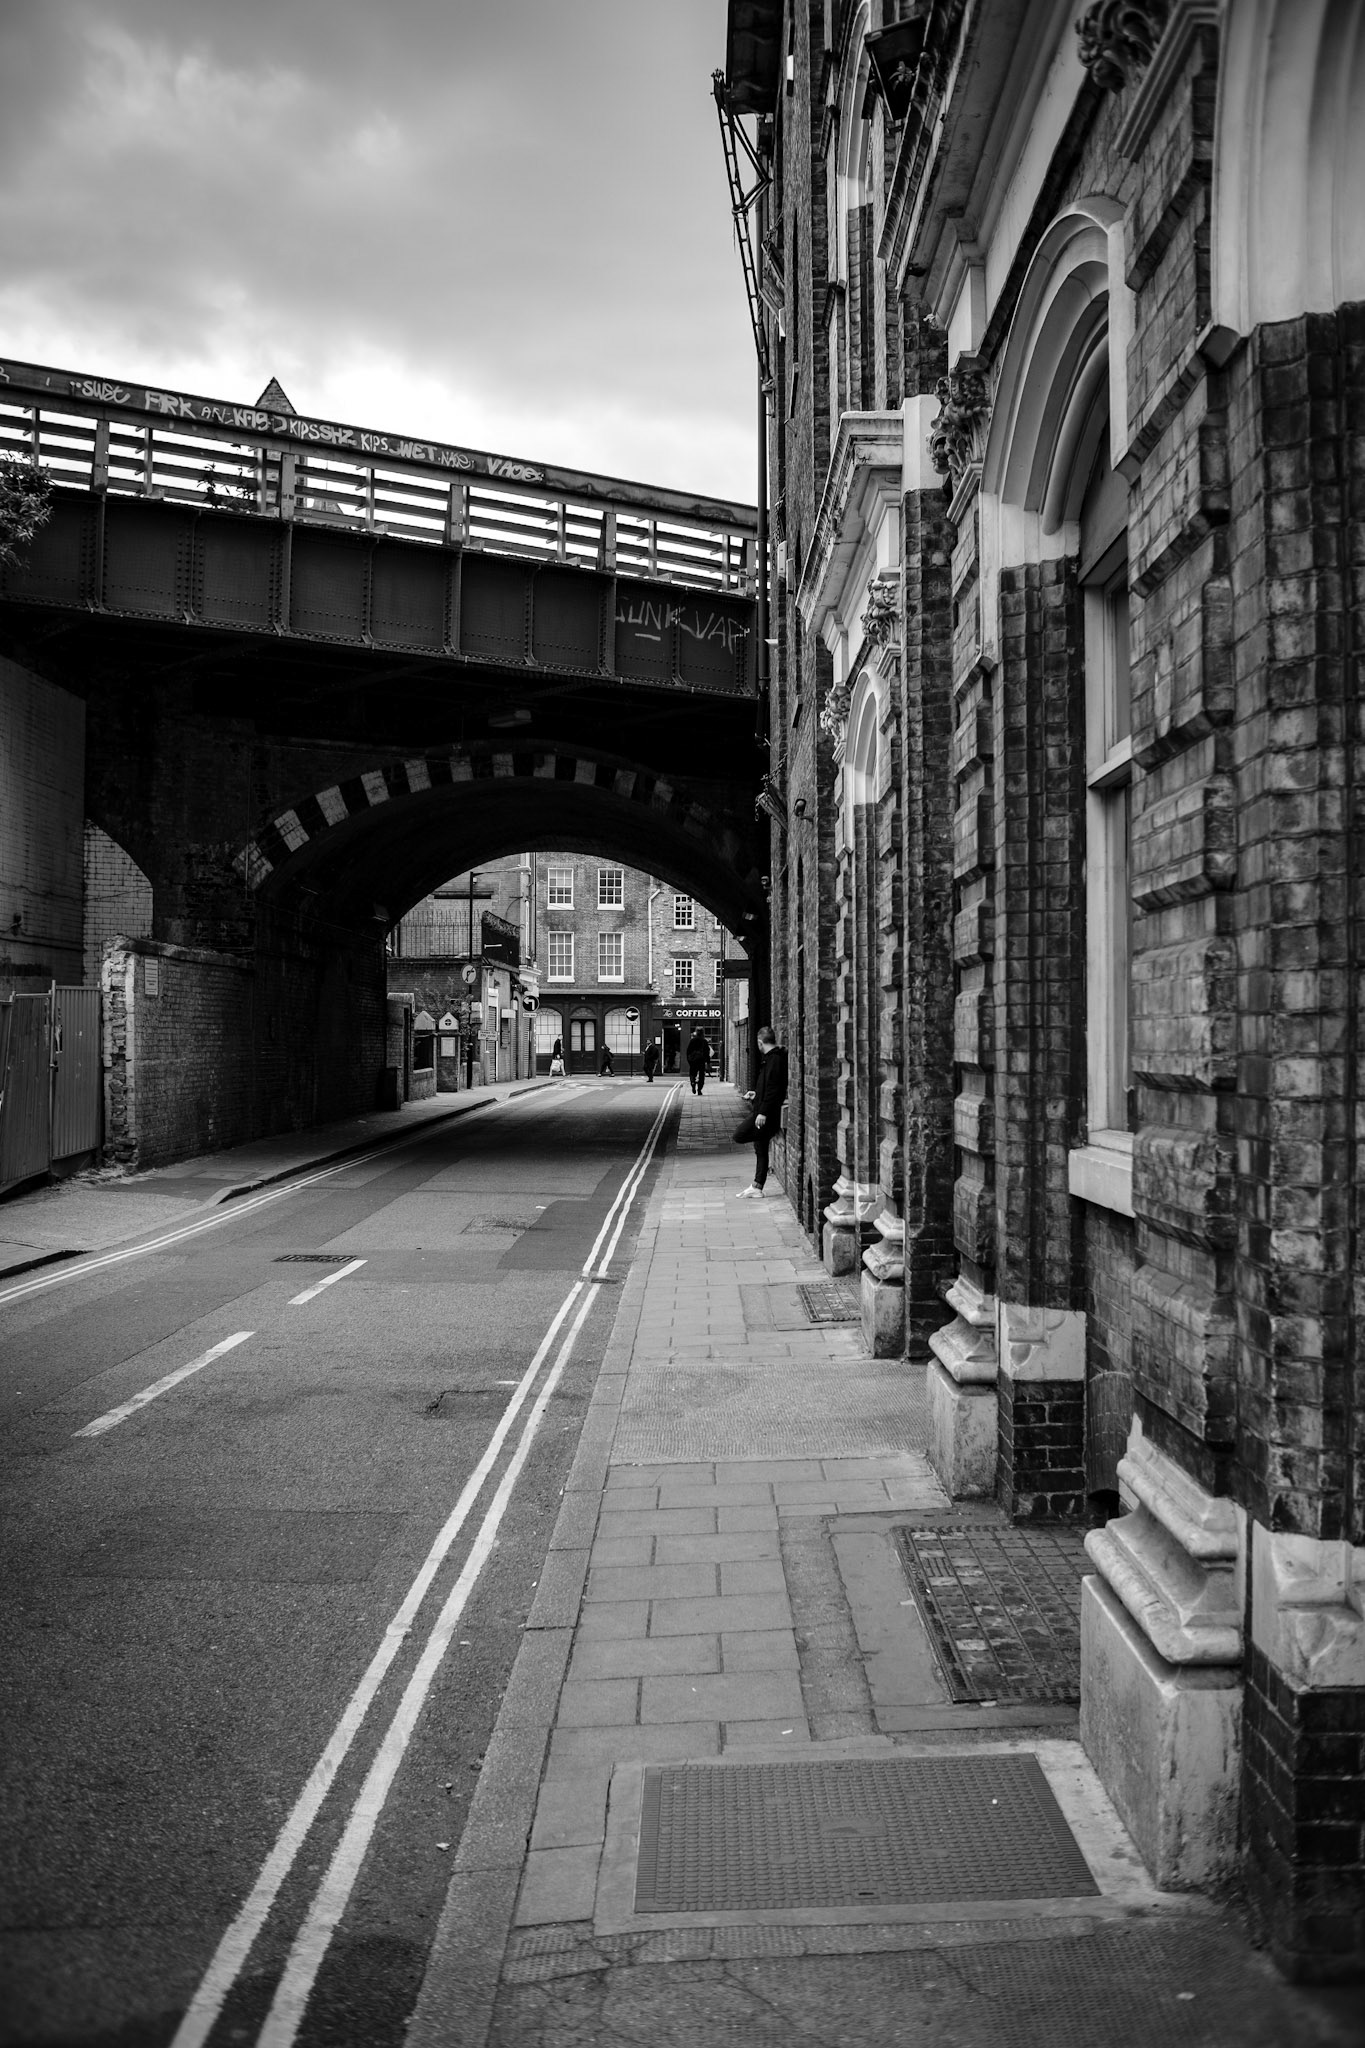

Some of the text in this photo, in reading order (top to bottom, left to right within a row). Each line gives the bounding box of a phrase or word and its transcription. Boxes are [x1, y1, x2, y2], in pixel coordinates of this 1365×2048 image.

[360, 433, 389, 453] KIPS
[675, 1009, 708, 1018] COFFEE
[708, 1009, 722, 1018] HO
